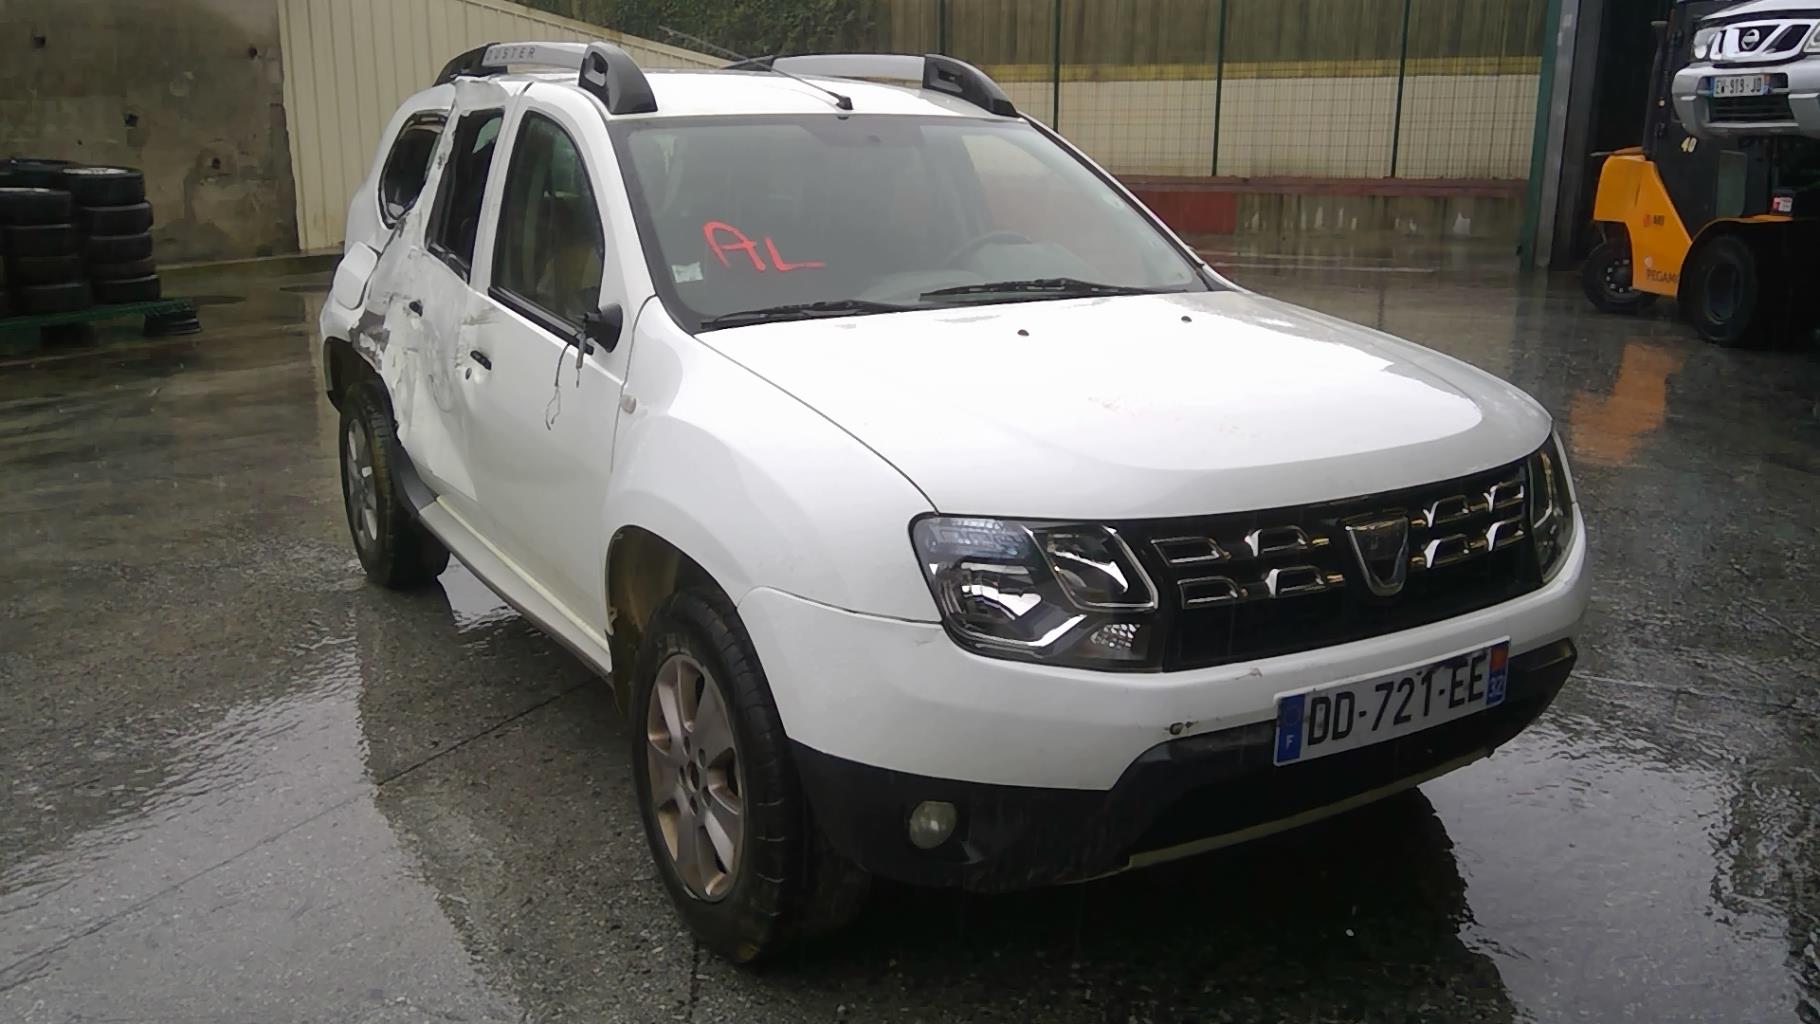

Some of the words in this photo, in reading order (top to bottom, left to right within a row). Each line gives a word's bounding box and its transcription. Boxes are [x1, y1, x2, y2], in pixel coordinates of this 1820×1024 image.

[1681, 135, 1698, 153] 40
[703, 220, 827, 272] AL
[1285, 734, 1294, 750] F
[1308, 650, 1488, 746] DD-721-EE
